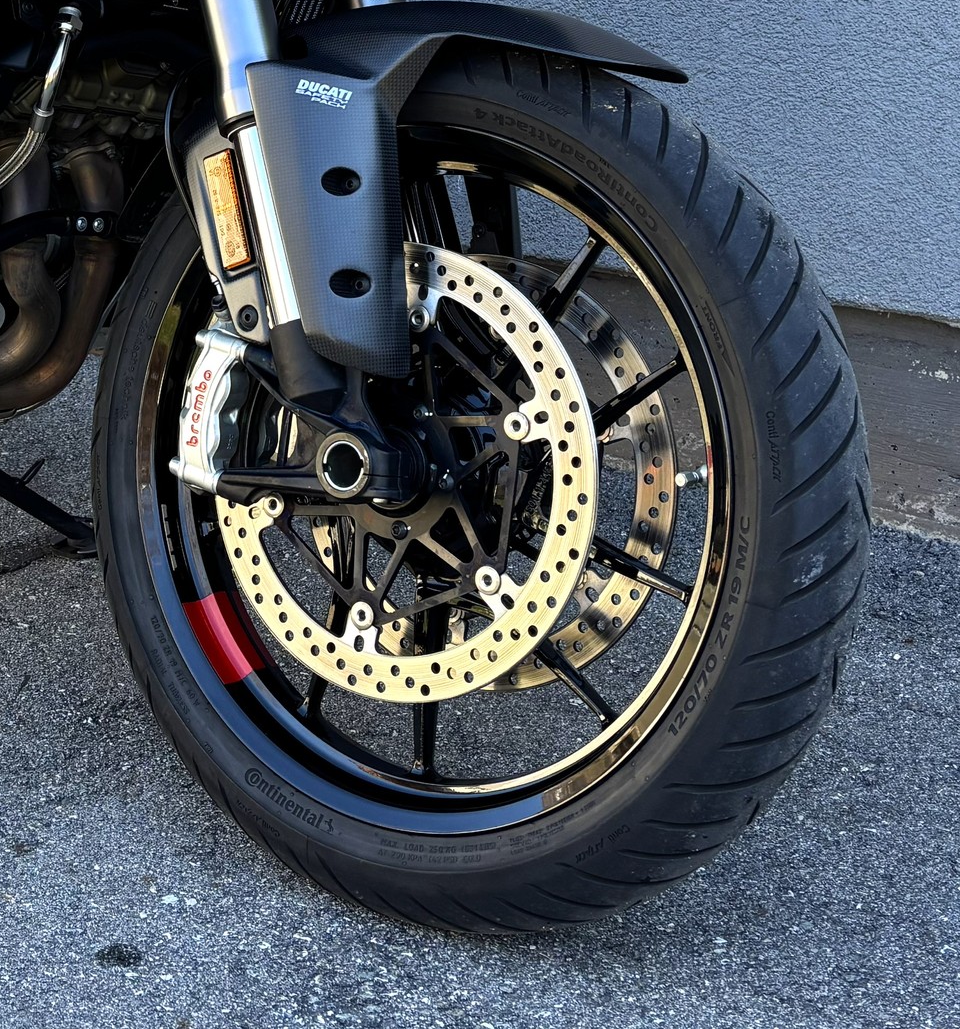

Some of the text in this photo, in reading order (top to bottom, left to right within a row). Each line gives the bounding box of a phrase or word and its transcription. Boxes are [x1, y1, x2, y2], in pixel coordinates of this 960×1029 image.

[295, 88, 350, 105] SAFETY
[296, 78, 353, 101] DUCATI
[310, 96, 347, 109] PACK
[473, 107, 659, 233] ContiRoadAttack 4
[186, 370, 212, 447] brembo
[667, 653, 718, 737] 120/70
[715, 611, 735, 650] ZR
[728, 576, 742, 607] 19
[735, 516, 750, 571] M/C
[244, 767, 325, 830] Continental
